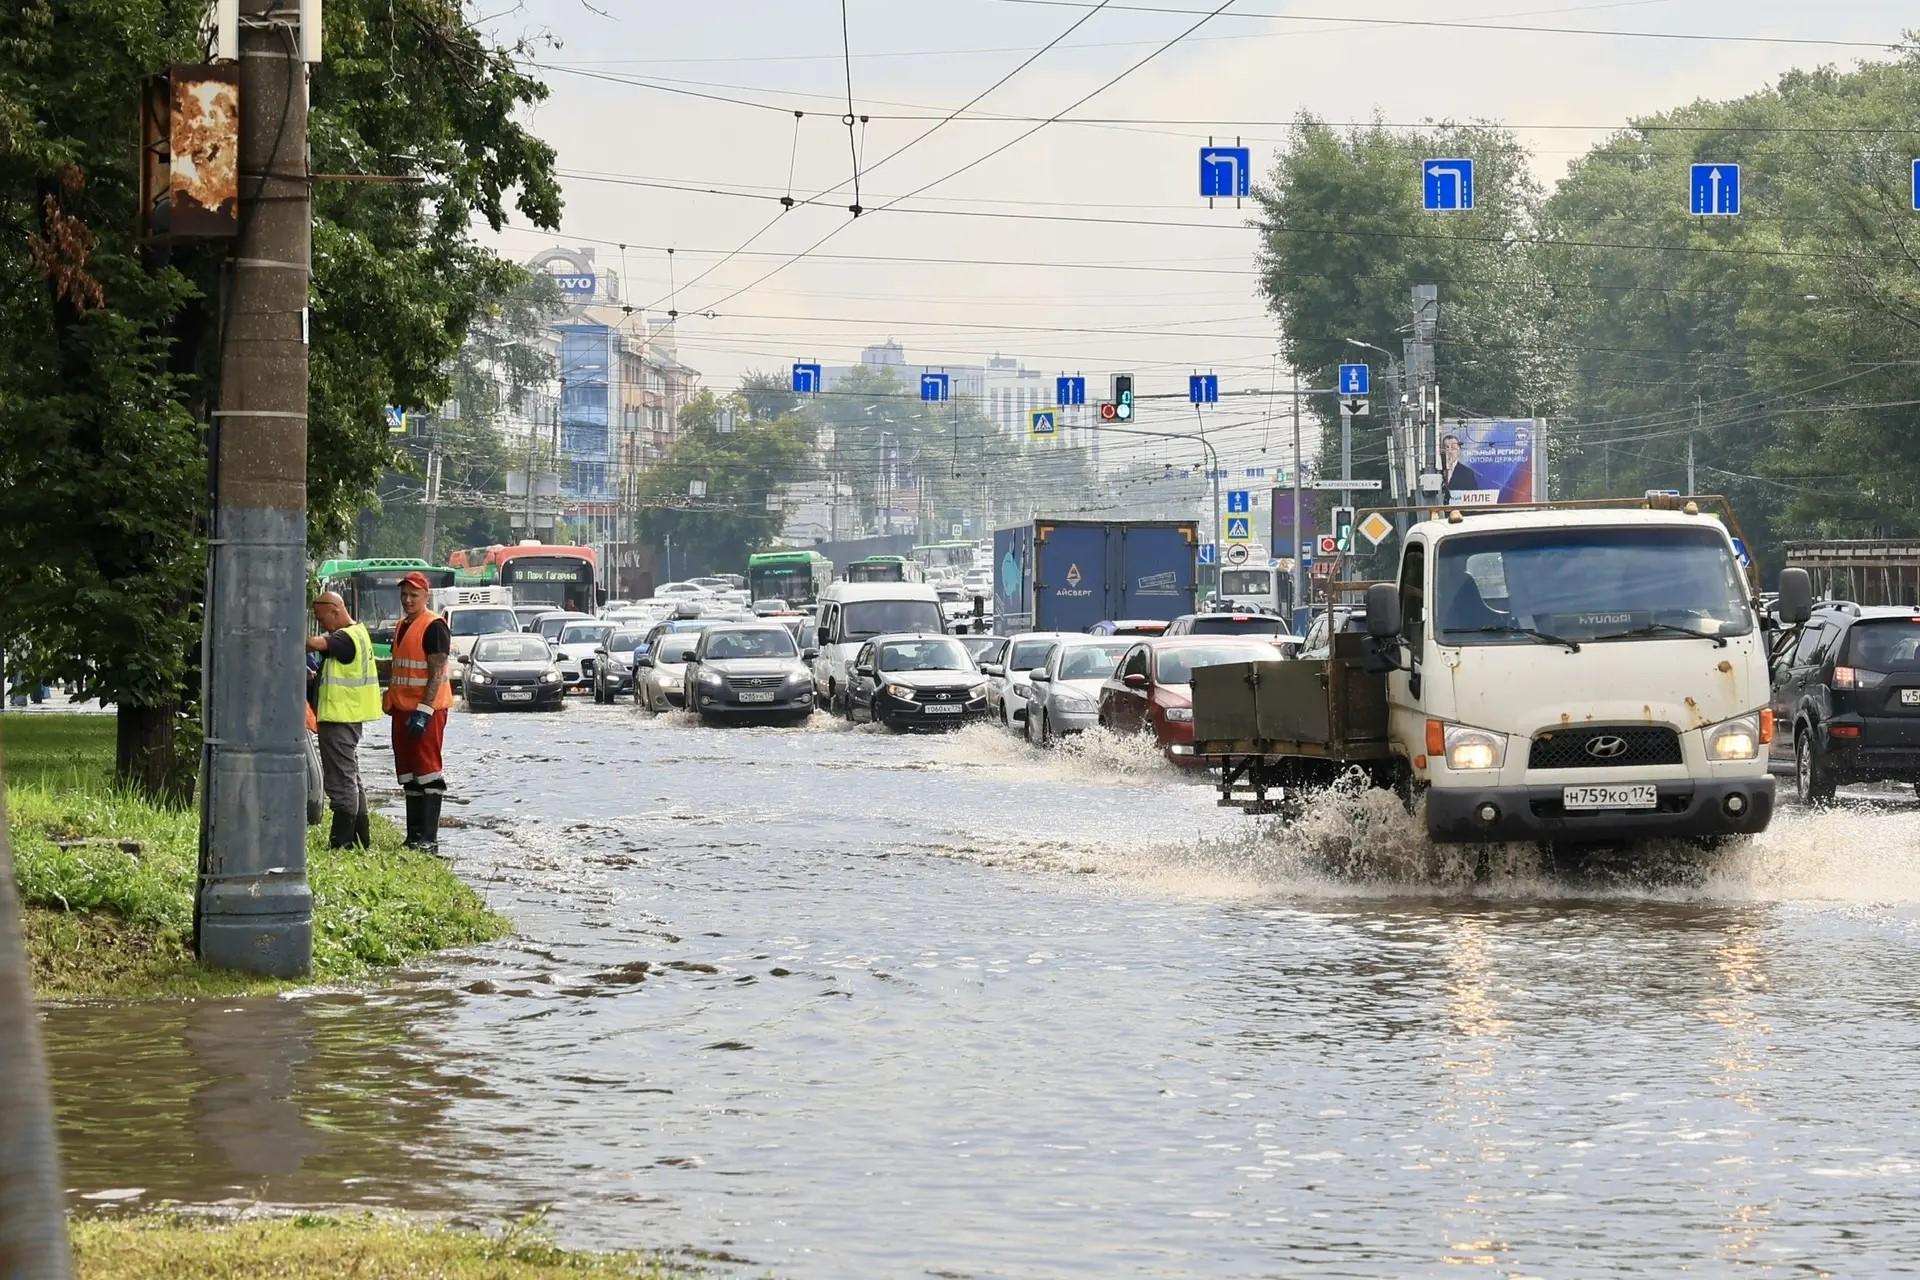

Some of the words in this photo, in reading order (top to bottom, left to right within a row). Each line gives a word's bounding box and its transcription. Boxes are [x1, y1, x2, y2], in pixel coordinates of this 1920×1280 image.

[1498, 448, 1524, 456] РЕГИОН
[1463, 494, 1490, 502] ИЛЛЕ
[515, 571, 523, 580] 19
[527, 571, 544, 580] Парк
[546, 571, 577, 580] Гагарина
[1569, 788, 1628, 803] Н759КО
